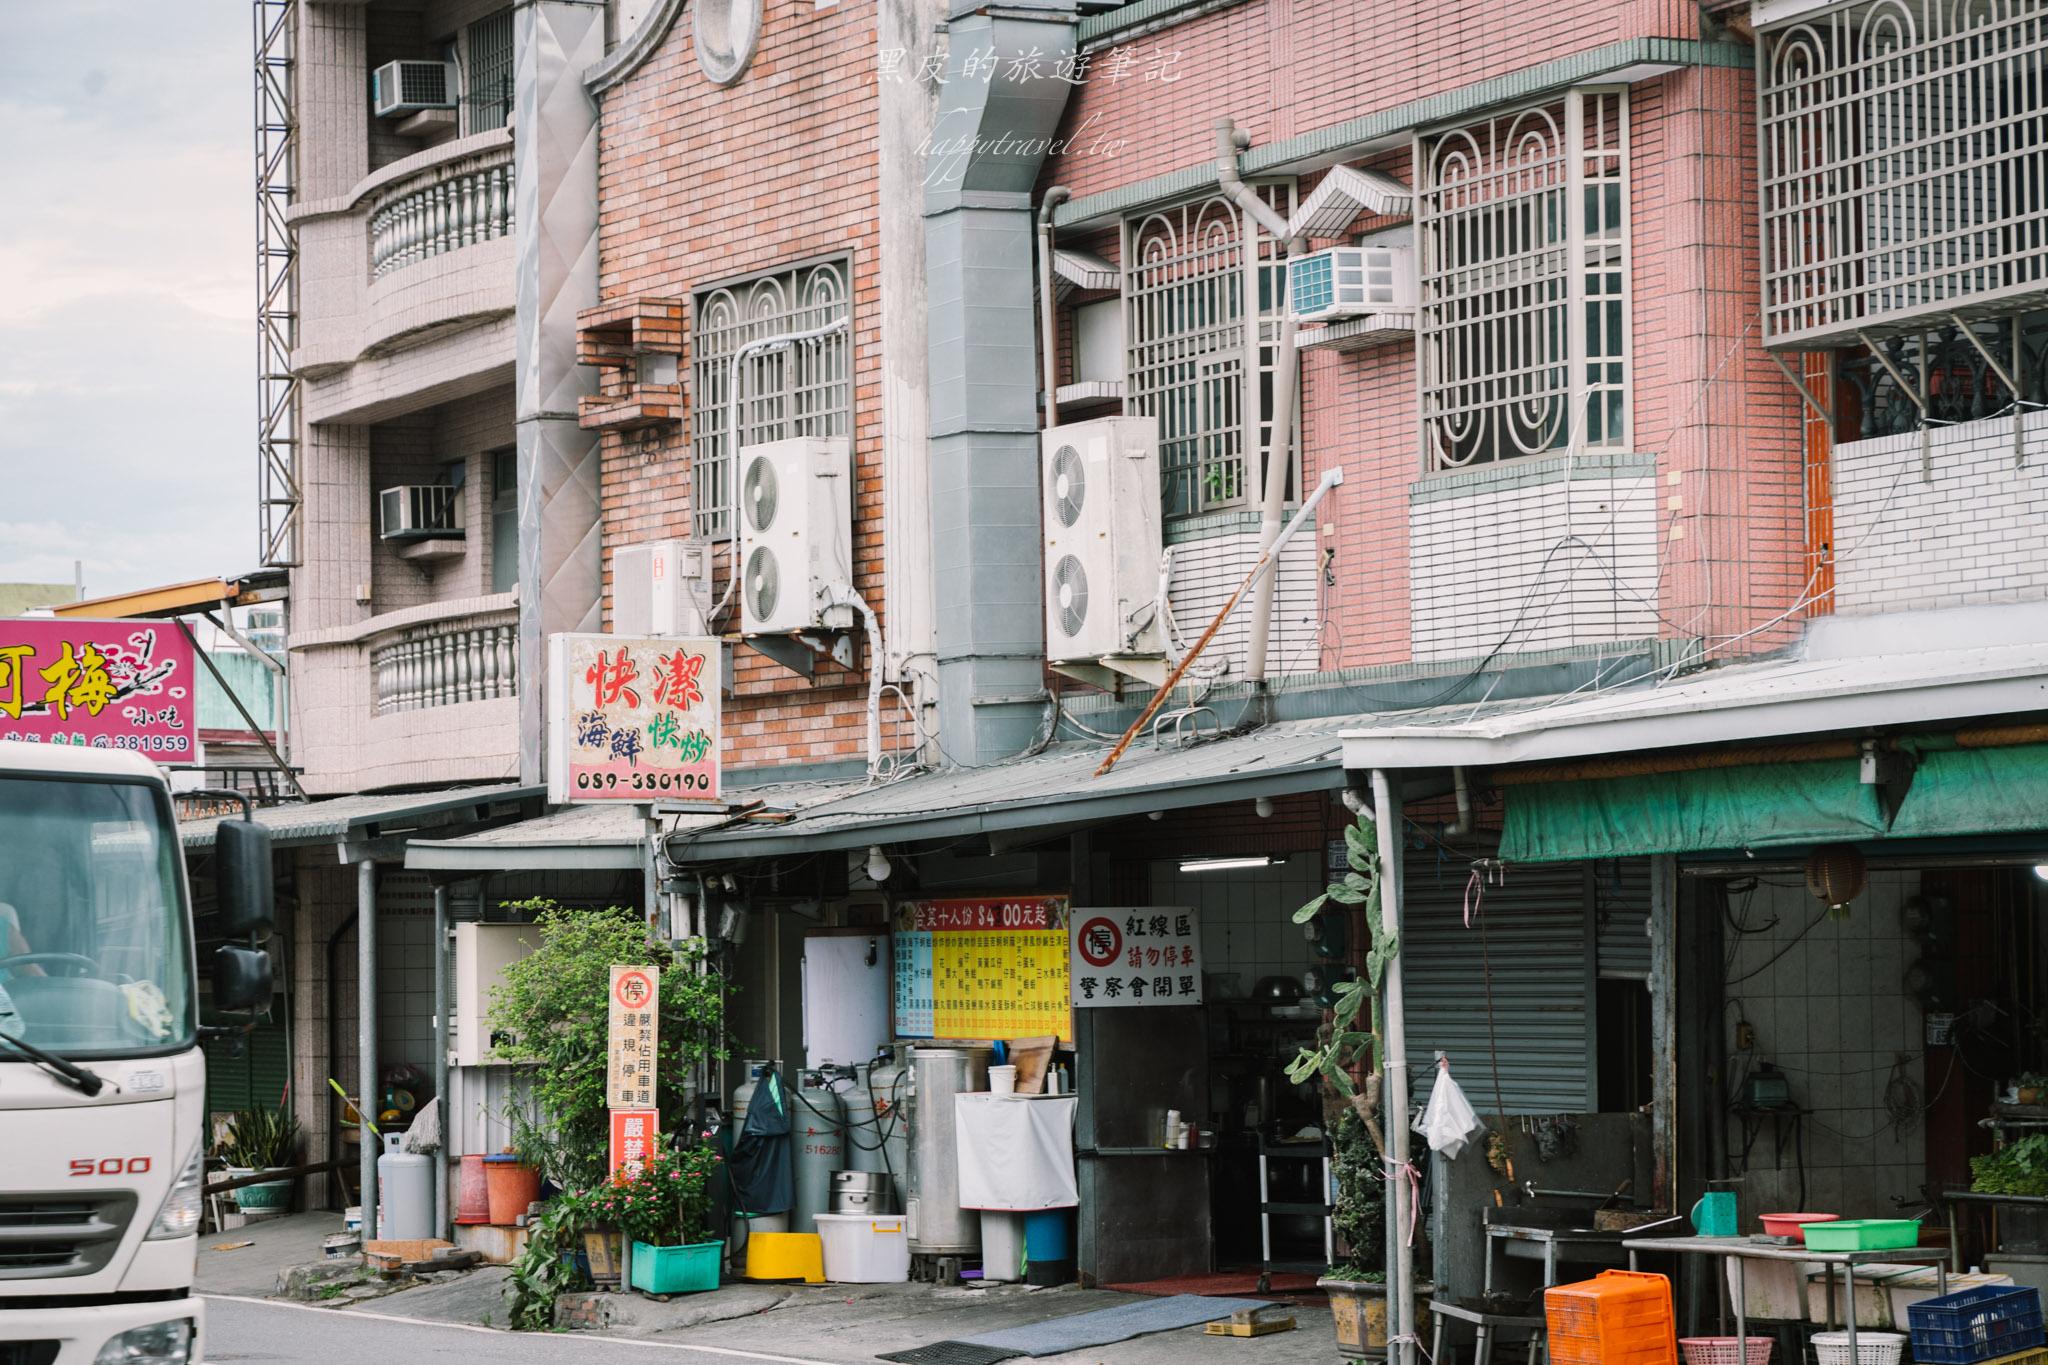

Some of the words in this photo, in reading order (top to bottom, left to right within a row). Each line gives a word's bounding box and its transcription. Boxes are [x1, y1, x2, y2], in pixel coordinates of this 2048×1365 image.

[586, 646, 706, 712] 快潔
[133, 707, 184, 729] 小吃
[115, 736, 188, 750] 381959
[577, 772, 710, 791] 089-380190
[914, 905, 974, 928] 合菜十人份
[1125, 914, 1191, 938] 紅線區
[1088, 928, 1112, 955] 停
[1127, 944, 1195, 968] 請勿停車
[623, 980, 645, 1001] 停
[1079, 974, 1196, 1000] 警察會開單
[621, 1013, 637, 1103] 違規停車
[637, 1013, 652, 1104] 嚴禁佔用車道
[69, 1156, 152, 1177] 500
